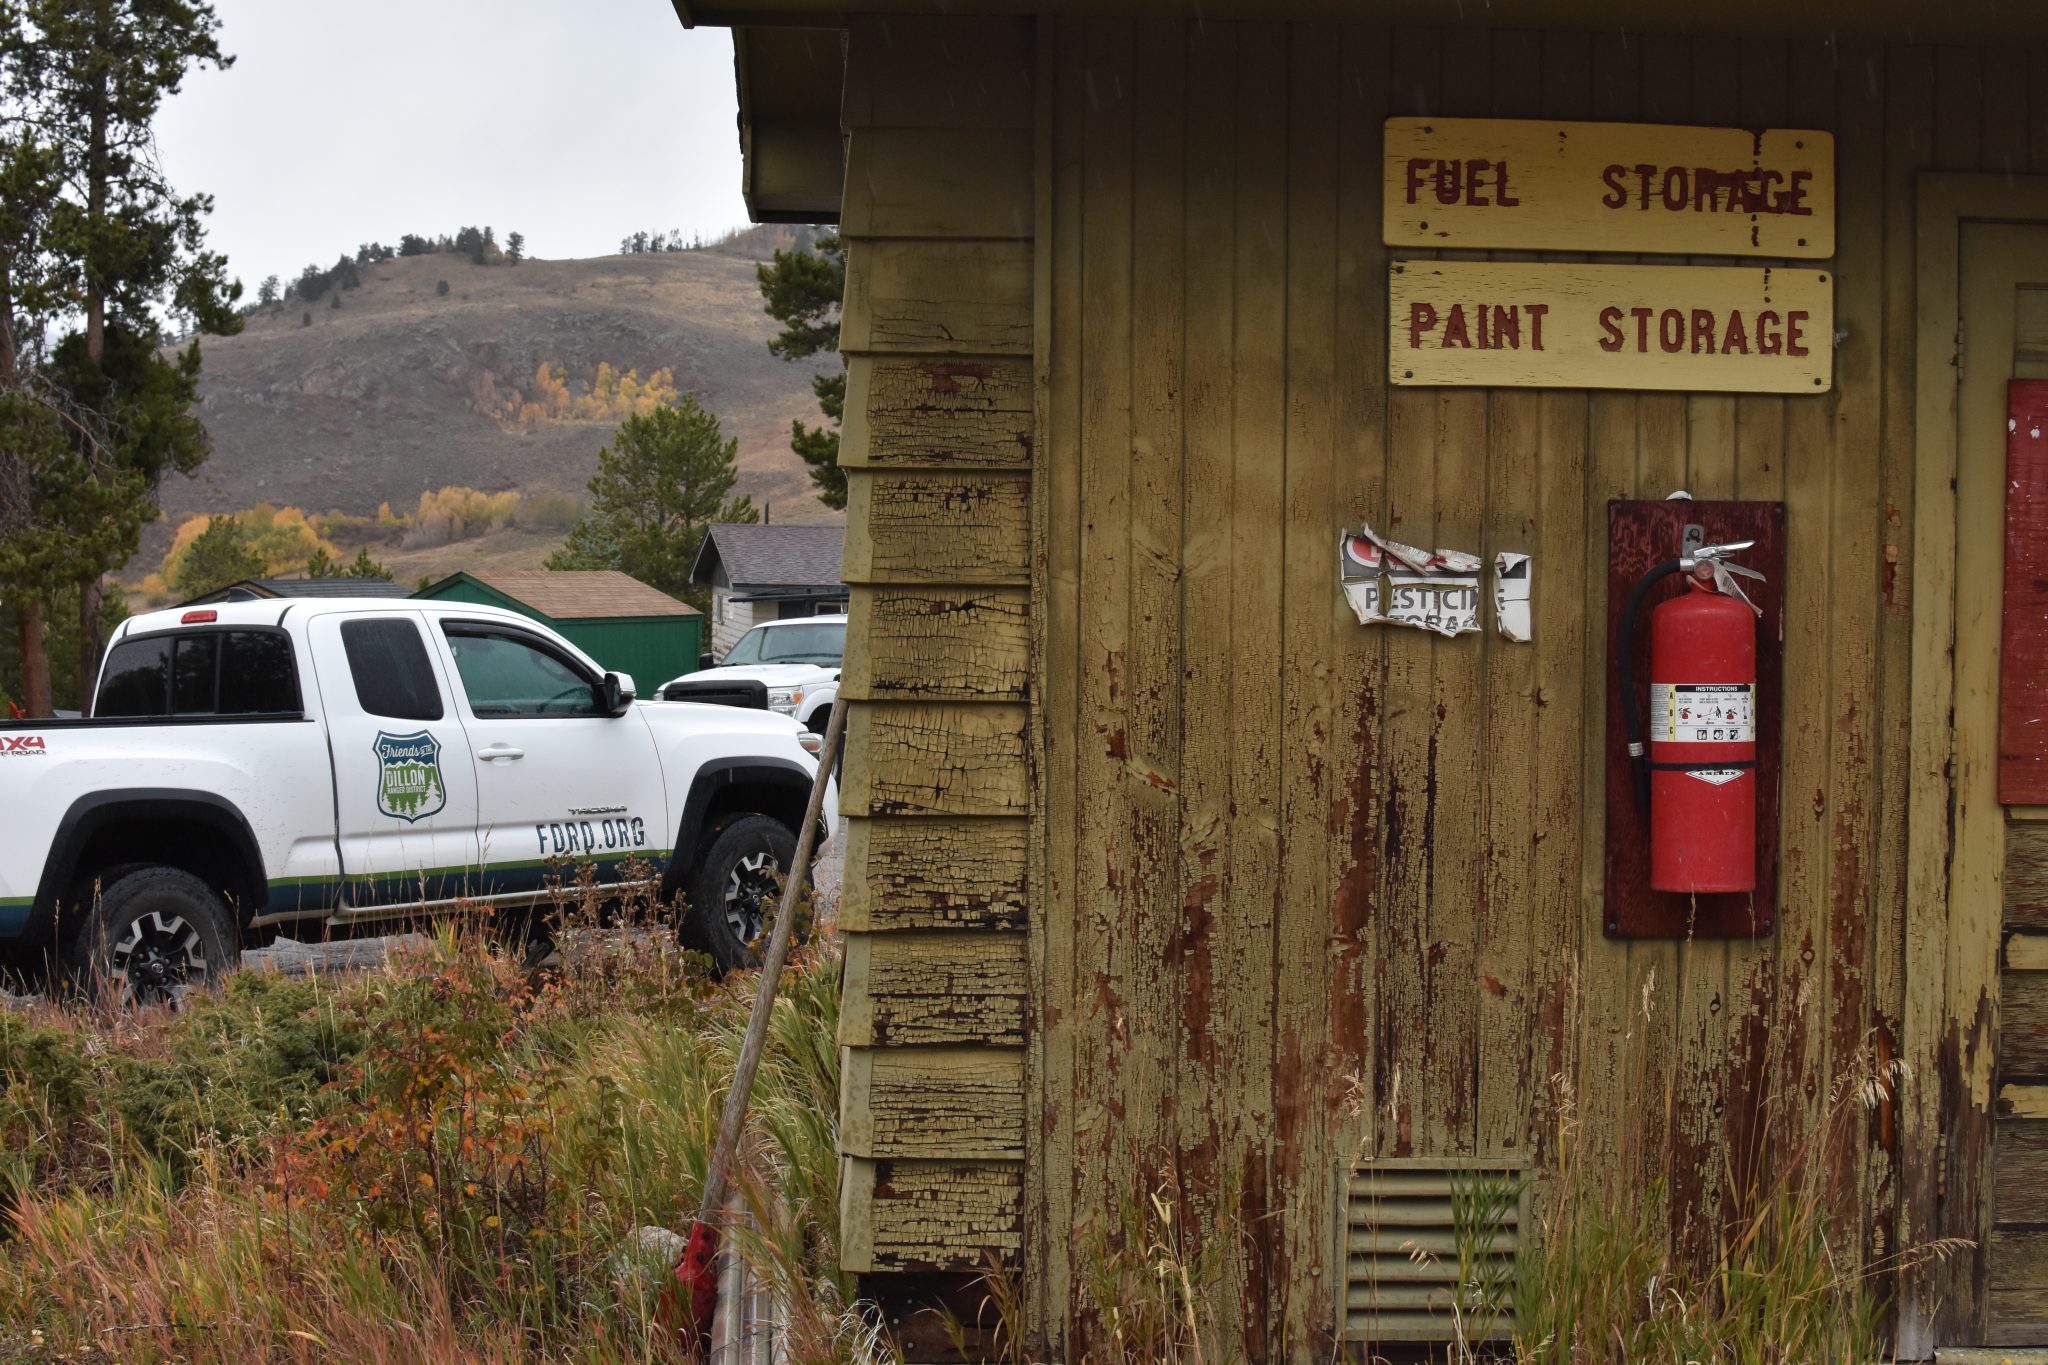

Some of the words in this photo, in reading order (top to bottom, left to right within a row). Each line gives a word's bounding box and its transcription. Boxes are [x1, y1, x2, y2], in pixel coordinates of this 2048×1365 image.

[1406, 158, 1519, 207] FUEL
[1602, 163, 1813, 215] STORAGE
[1409, 302, 1549, 351] PAINT
[1599, 306, 1809, 356] STORAGE
[1669, 709, 1674, 717] B
[381, 744, 420, 759] Friends
[386, 769, 425, 787] DILLON
[536, 816, 645, 854] FDRD.ORG
